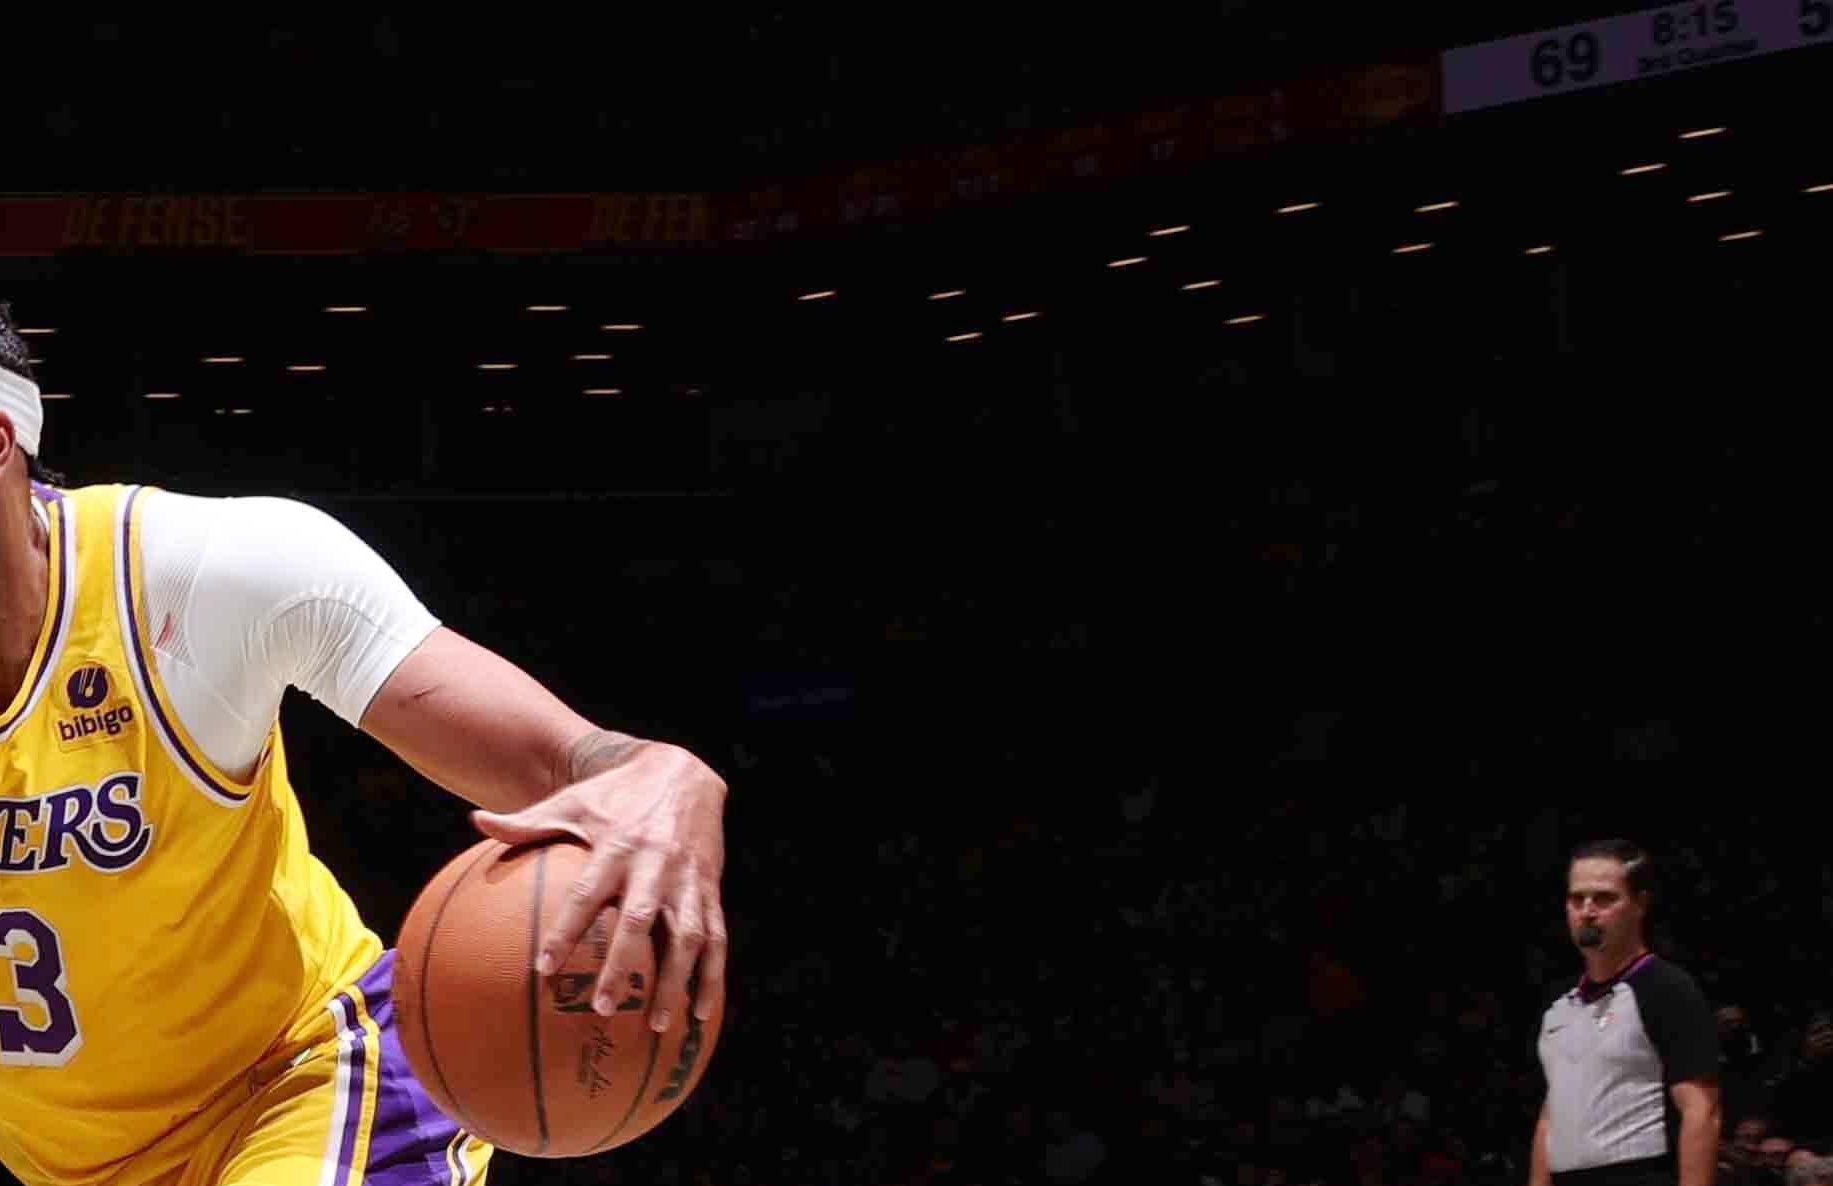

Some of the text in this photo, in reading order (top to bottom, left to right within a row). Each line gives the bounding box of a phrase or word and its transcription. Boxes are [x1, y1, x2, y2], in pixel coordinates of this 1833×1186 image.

[1652, 1, 1739, 46] 8:15
[1532, 33, 1596, 86] 69
[59, 701, 135, 742] bibigo
